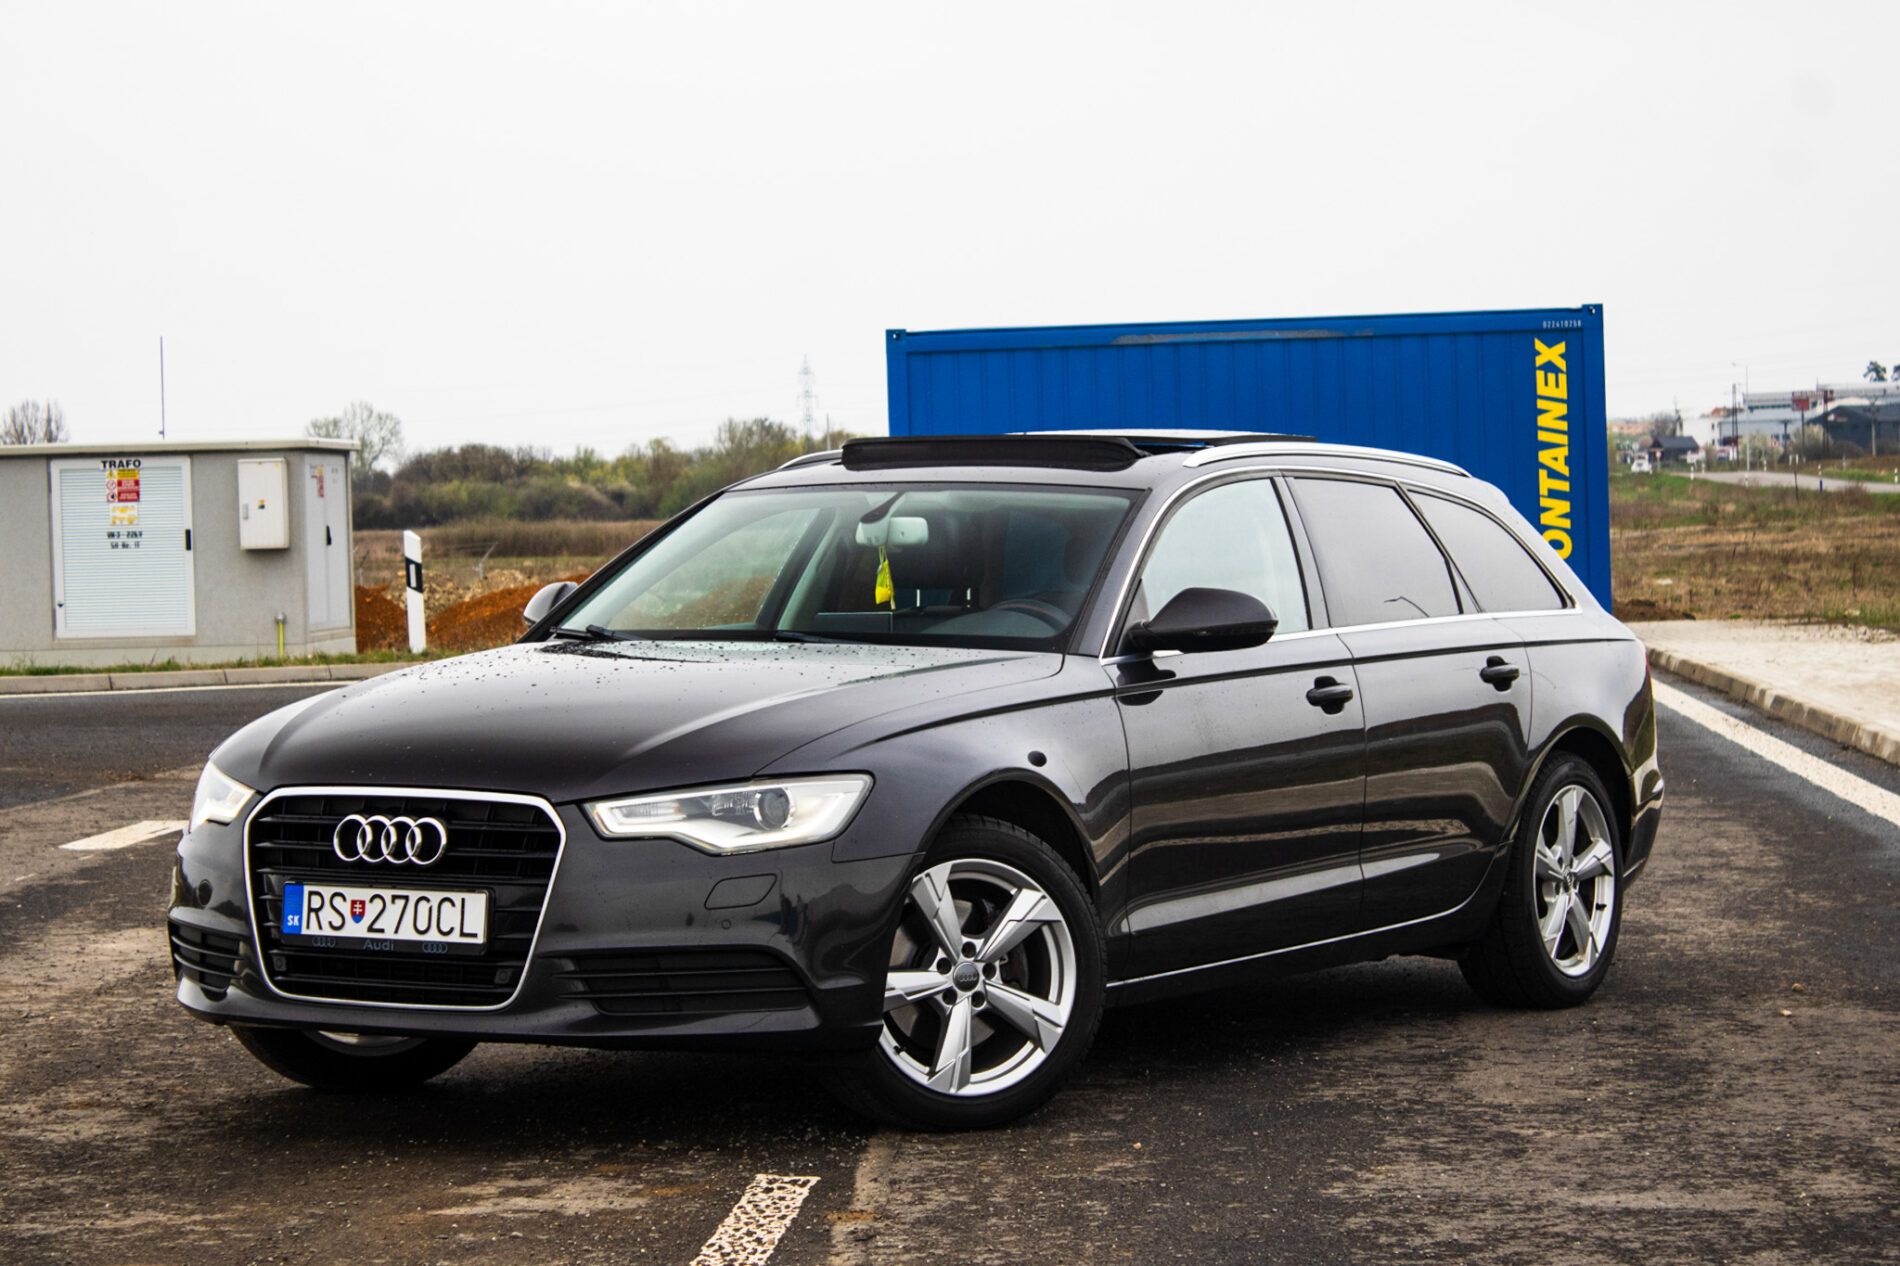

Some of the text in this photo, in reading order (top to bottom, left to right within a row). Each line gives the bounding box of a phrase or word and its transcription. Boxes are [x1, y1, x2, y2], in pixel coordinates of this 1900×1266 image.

[1534, 337, 1573, 560] ONTAINEX
[101, 459, 142, 468] TRAFO
[287, 914, 300, 926] SK
[306, 890, 479, 938] RS 270CL
[363, 940, 394, 951] Audi
